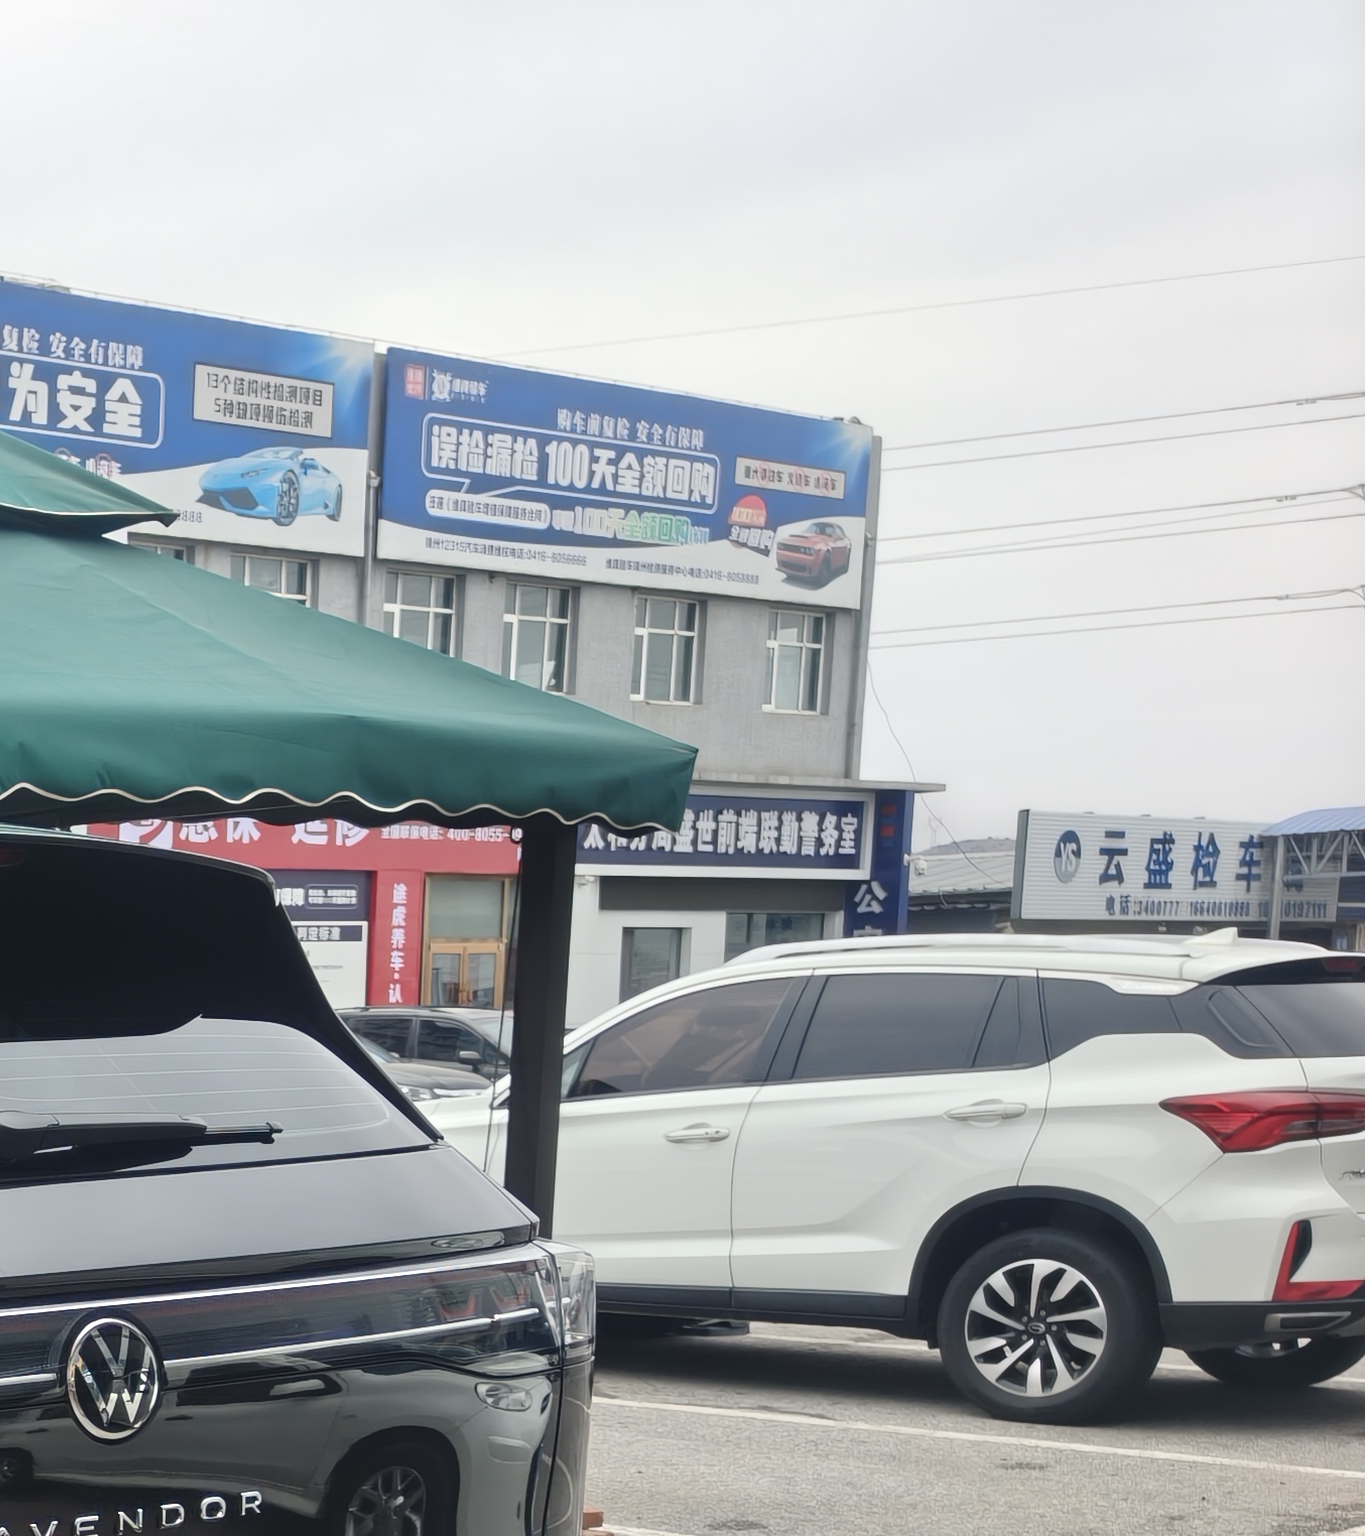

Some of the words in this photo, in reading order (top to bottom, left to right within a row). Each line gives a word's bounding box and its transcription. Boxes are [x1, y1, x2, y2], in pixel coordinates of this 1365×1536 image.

[49, 332, 144, 370] 安全有保障
[430, 424, 539, 481] 误检漏检
[544, 440, 717, 505] 100天全额回购
